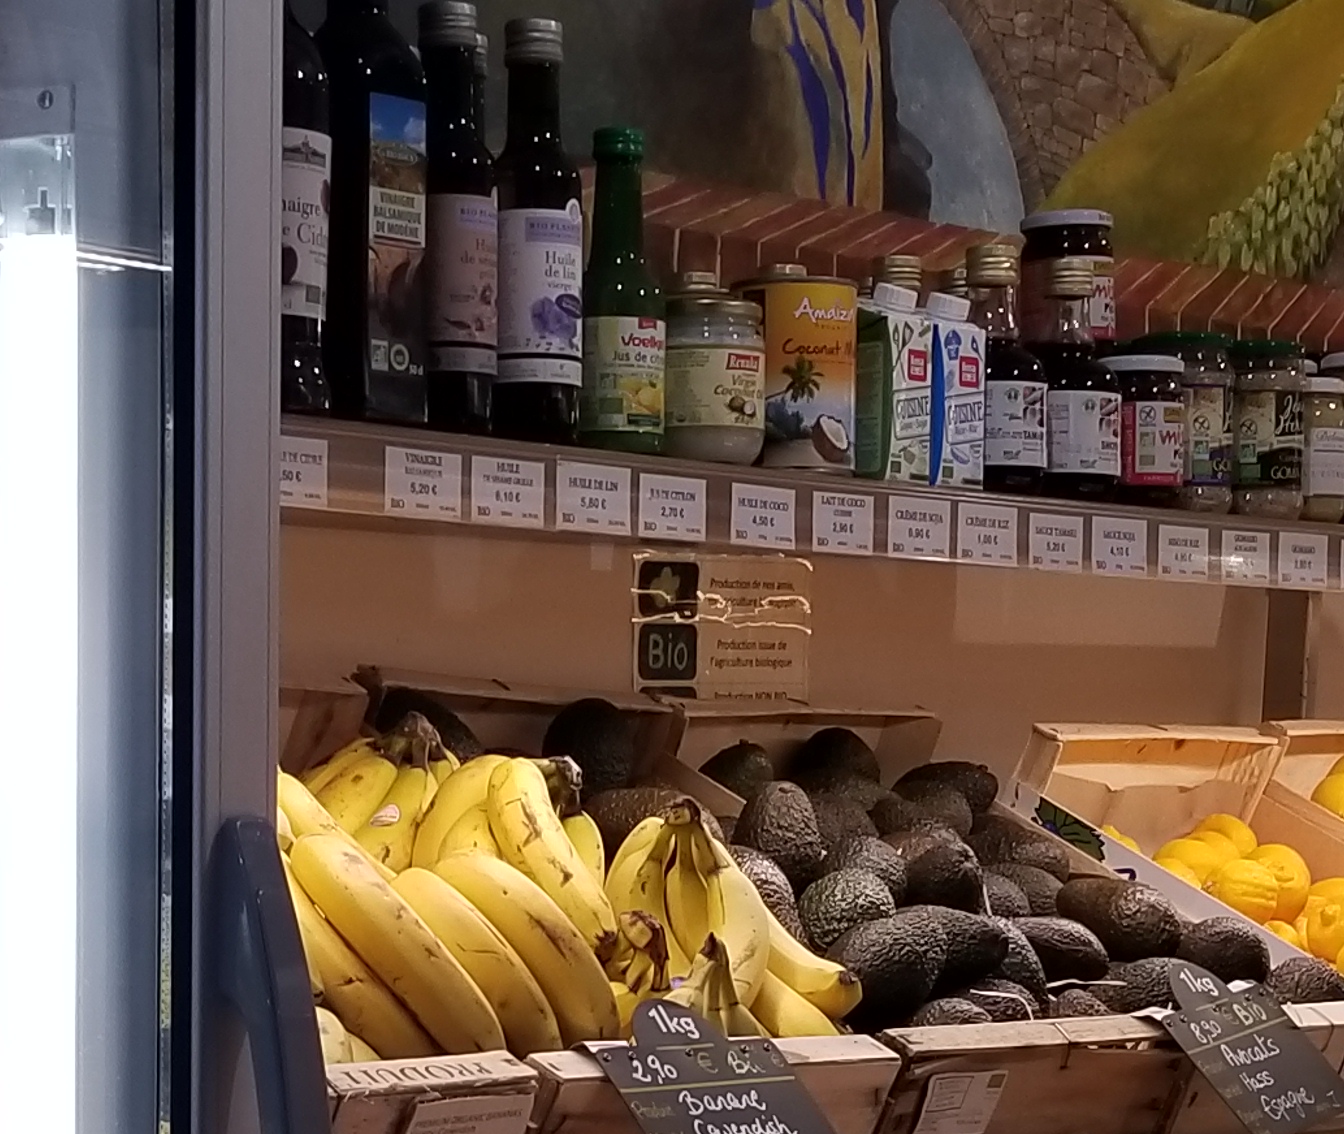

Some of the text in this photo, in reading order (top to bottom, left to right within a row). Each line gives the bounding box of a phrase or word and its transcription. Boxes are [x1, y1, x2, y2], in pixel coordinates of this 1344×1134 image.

[545, 250, 576, 267] Huile
[545, 267, 575, 280] de lin
[612, 350, 647, 363] Jus de
[782, 339, 838, 355] Coconut
[410, 483, 430, 495] 5,20
[606, 480, 618, 491] LIN
[710, 578, 751, 589] Production
[648, 633, 688, 671] Bio
[717, 639, 757, 650] Production
[778, 640, 787, 650] de
[1179, 968, 1219, 997] 1kg
[648, 1005, 700, 1039] 1kg
[1190, 1001, 1267, 1044] 8,90 Bio
[1220, 1034, 1280, 1067] Avocats
[697, 1052, 718, 1074] €
[1239, 1070, 1275, 1092] Hass
[678, 1090, 766, 1115] Banane
[1261, 1087, 1315, 1122] Espagne
